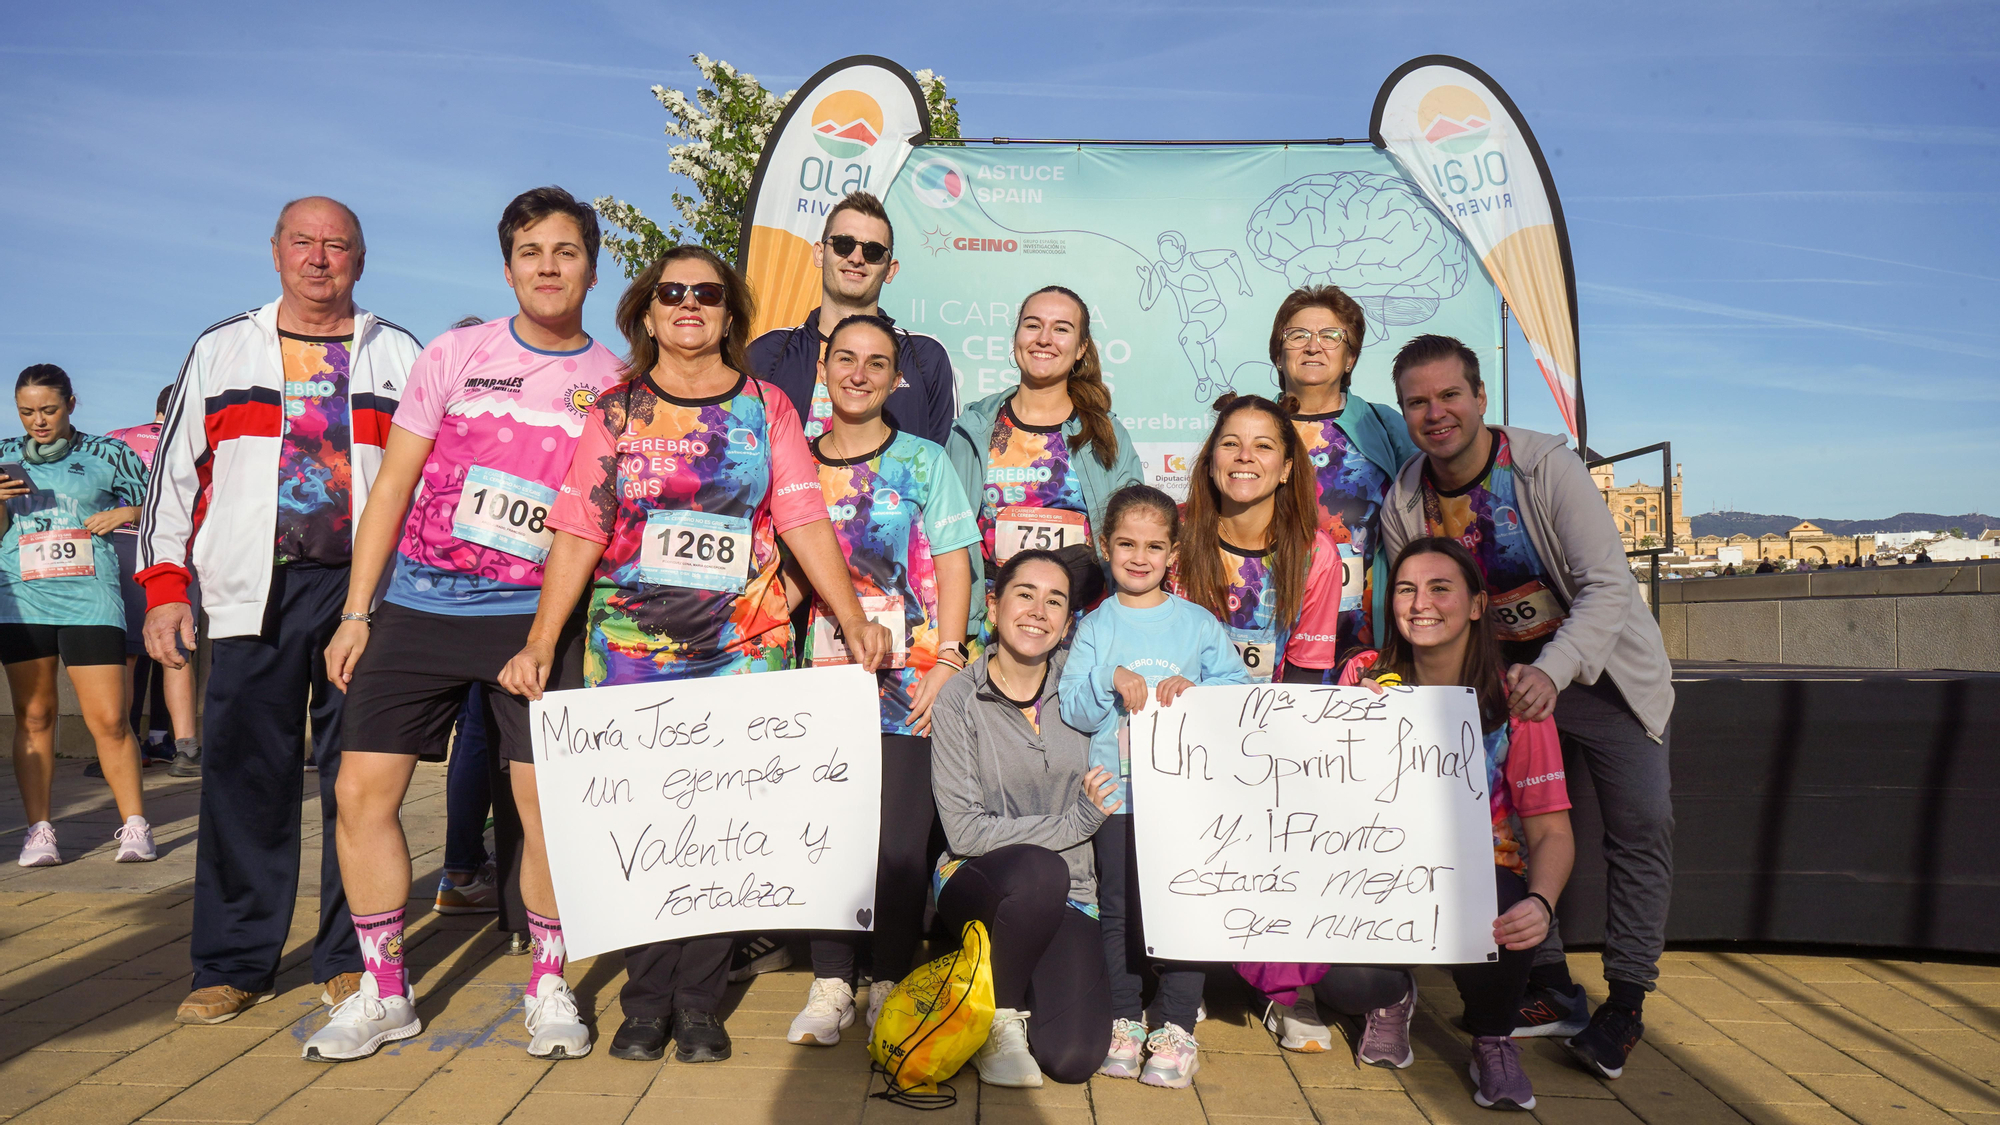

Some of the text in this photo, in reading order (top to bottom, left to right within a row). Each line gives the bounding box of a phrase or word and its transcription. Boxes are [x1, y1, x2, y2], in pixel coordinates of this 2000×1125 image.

[977, 164, 1065, 181] ASTUCE
[977, 187, 1042, 204] SPAIN
[797, 198, 831, 217] RIV
[953, 237, 1018, 253] GEINO
[807, 422, 822, 436] IS
[1119, 413, 1211, 431] erebral
[617, 439, 706, 455] CEREBRO
[621, 457, 676, 475] NO ES
[987, 467, 1049, 483] EREBRO
[624, 479, 661, 499] GRIS
[777, 481, 822, 497] astucesp
[1005, 488, 1026, 501] ES
[473, 488, 548, 534] 1008
[934, 508, 975, 529] astuces
[657, 528, 735, 564] 1268
[1017, 525, 1065, 551] 751
[35, 541, 77, 562] 189
[1155, 659, 1169, 668] NO
[1169, 663, 1181, 675] ES
[542, 705, 629, 761] María
[747, 712, 812, 742] eres
[1151, 710, 1213, 781] Un
[1234, 728, 1367, 808] Sprint
[582, 747, 849, 810] un ejemplo de
[609, 814, 774, 882] Valentía
[1168, 861, 1455, 905] estarás mejor
[655, 872, 807, 921] Fortaleza
[1305, 904, 1440, 951] nunca!
